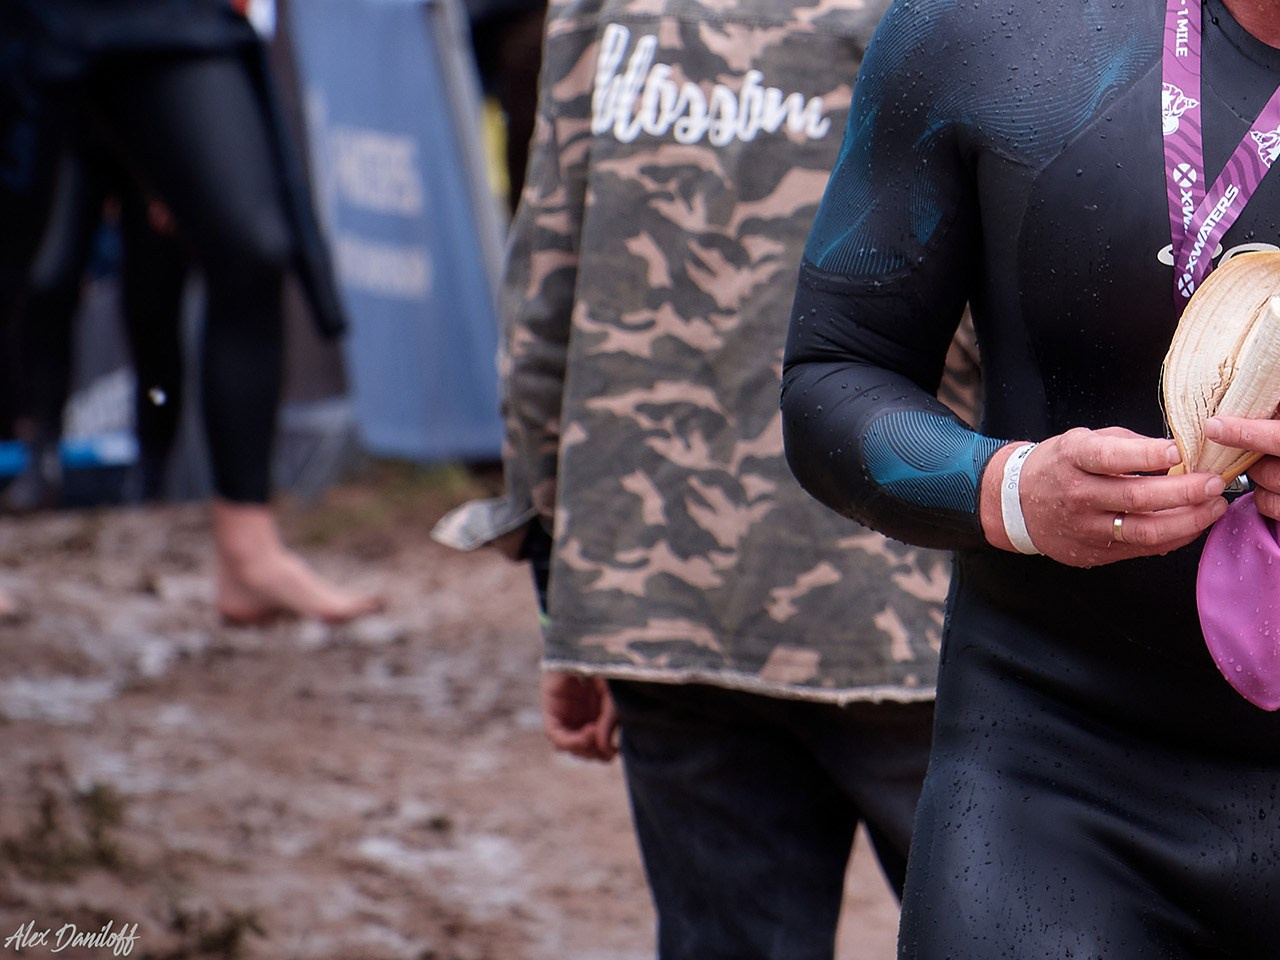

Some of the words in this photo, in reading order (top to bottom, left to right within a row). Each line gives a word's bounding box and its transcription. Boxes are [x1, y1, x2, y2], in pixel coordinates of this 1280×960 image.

[1176, 7, 1189, 15] 1
[1175, 18, 1189, 58] MILE
[591, 22, 832, 147] blossom
